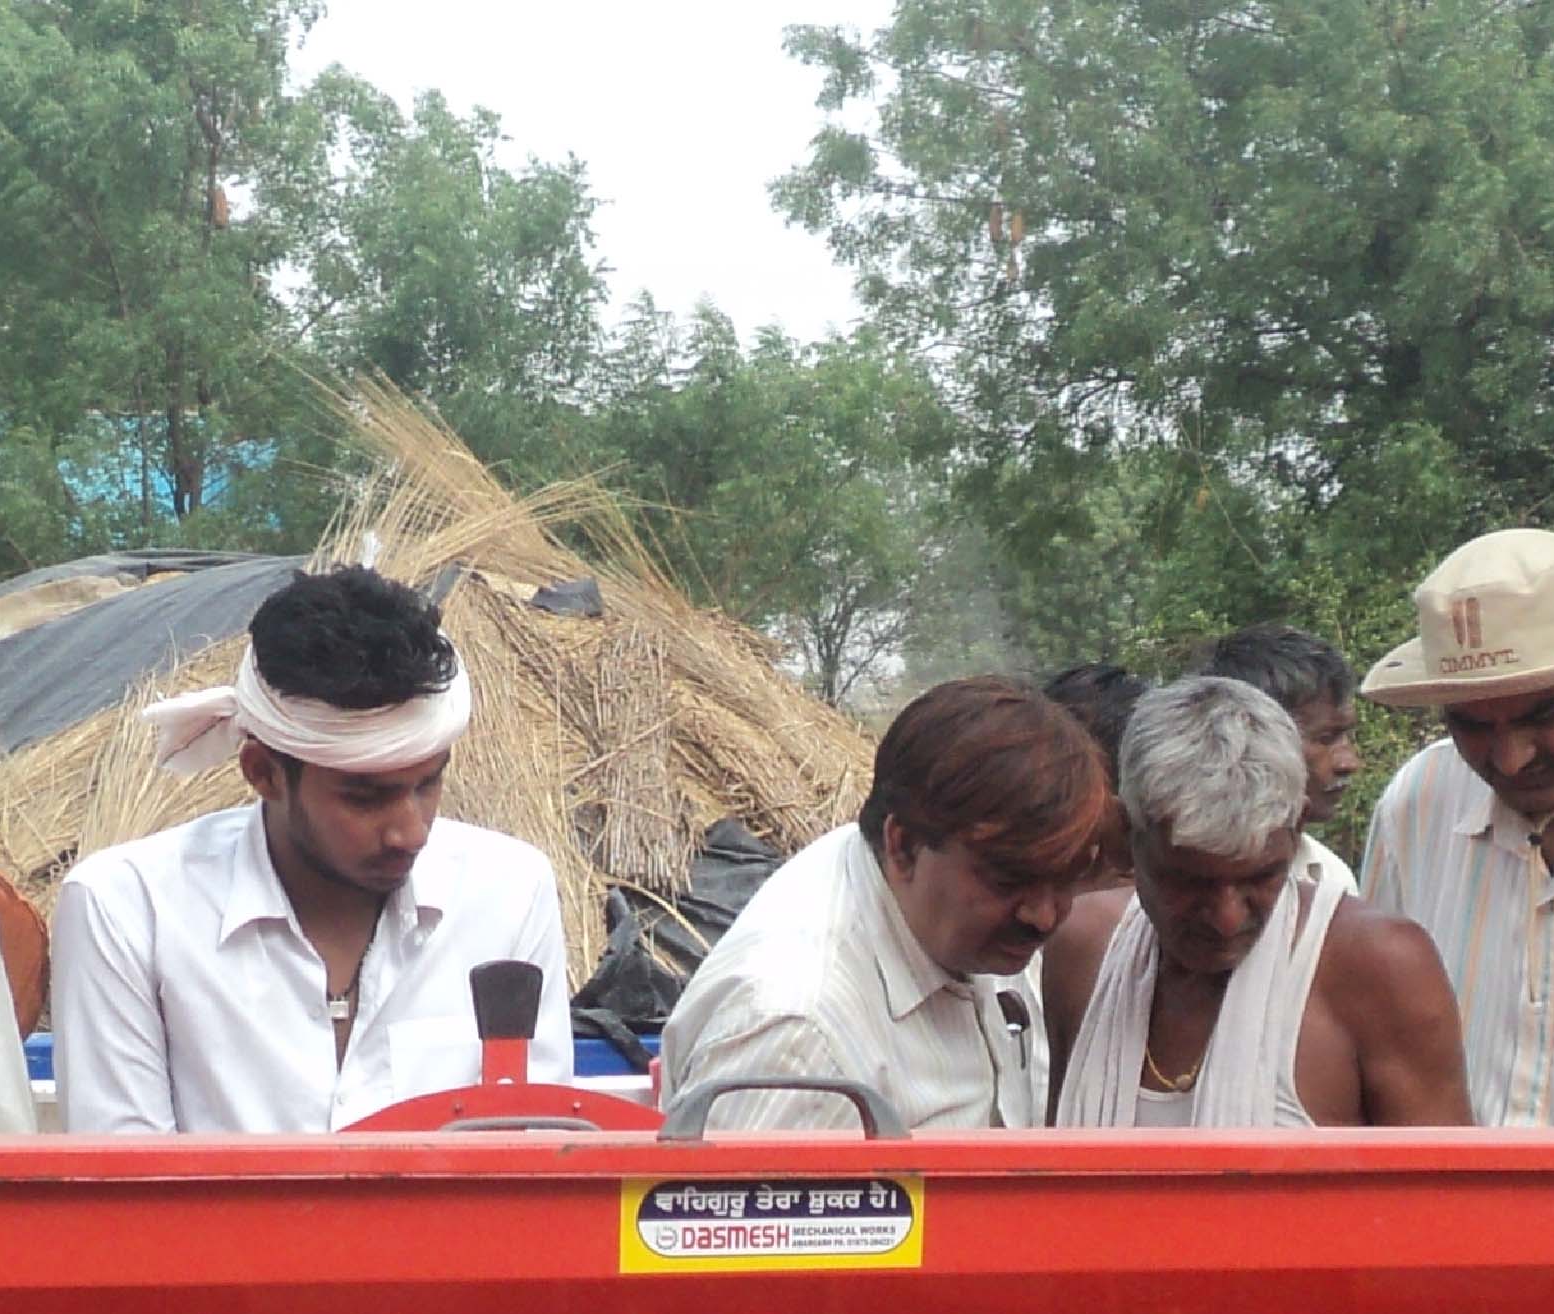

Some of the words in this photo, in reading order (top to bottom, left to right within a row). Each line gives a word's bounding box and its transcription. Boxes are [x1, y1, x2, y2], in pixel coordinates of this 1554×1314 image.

[755, 1184, 801, 1210] ਤੇਰਾ
[681, 1225, 789, 1250] DASMESH
[792, 1226, 856, 1236] MECHANICAL
[860, 1225, 896, 1235] WORKS
